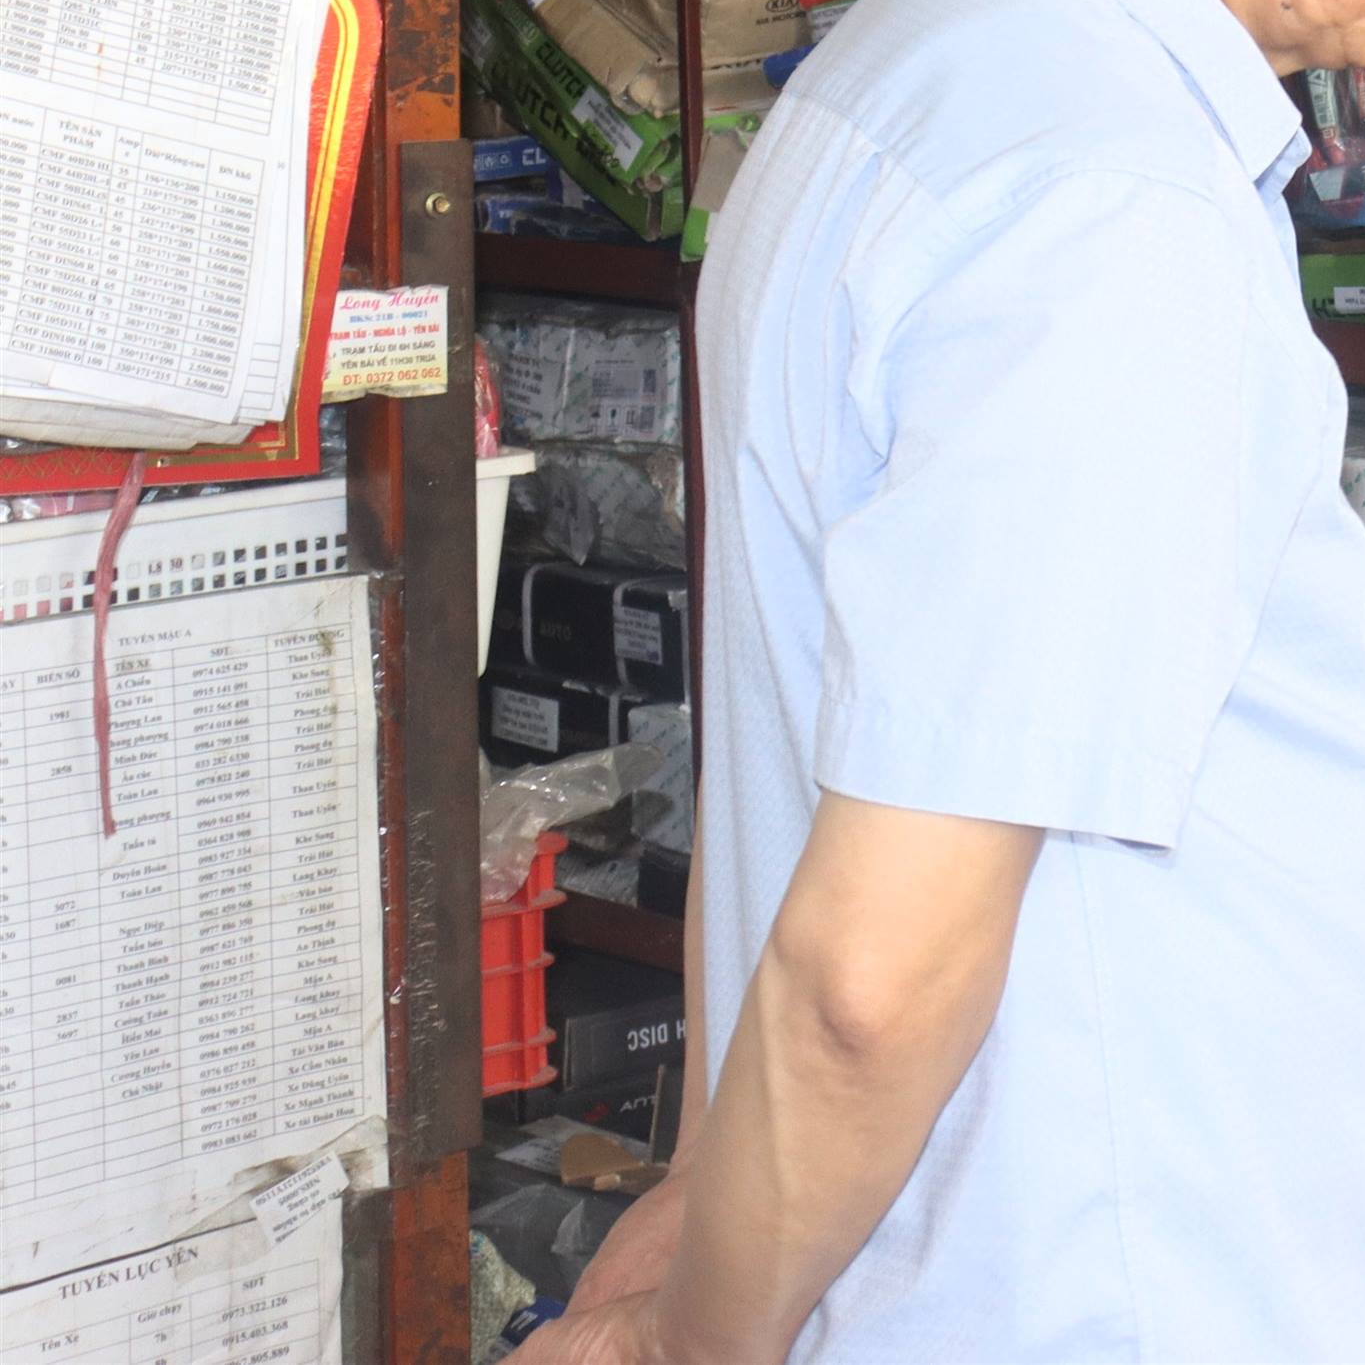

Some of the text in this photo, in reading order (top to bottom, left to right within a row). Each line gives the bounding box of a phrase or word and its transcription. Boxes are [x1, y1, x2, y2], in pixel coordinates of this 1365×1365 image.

[339, 295, 382, 311] Long
[366, 371, 395, 384] 0372
[626, 1022, 669, 1052] DISC
[125, 1258, 161, 1283] LỤC
[164, 1244, 201, 1270] YÊN
